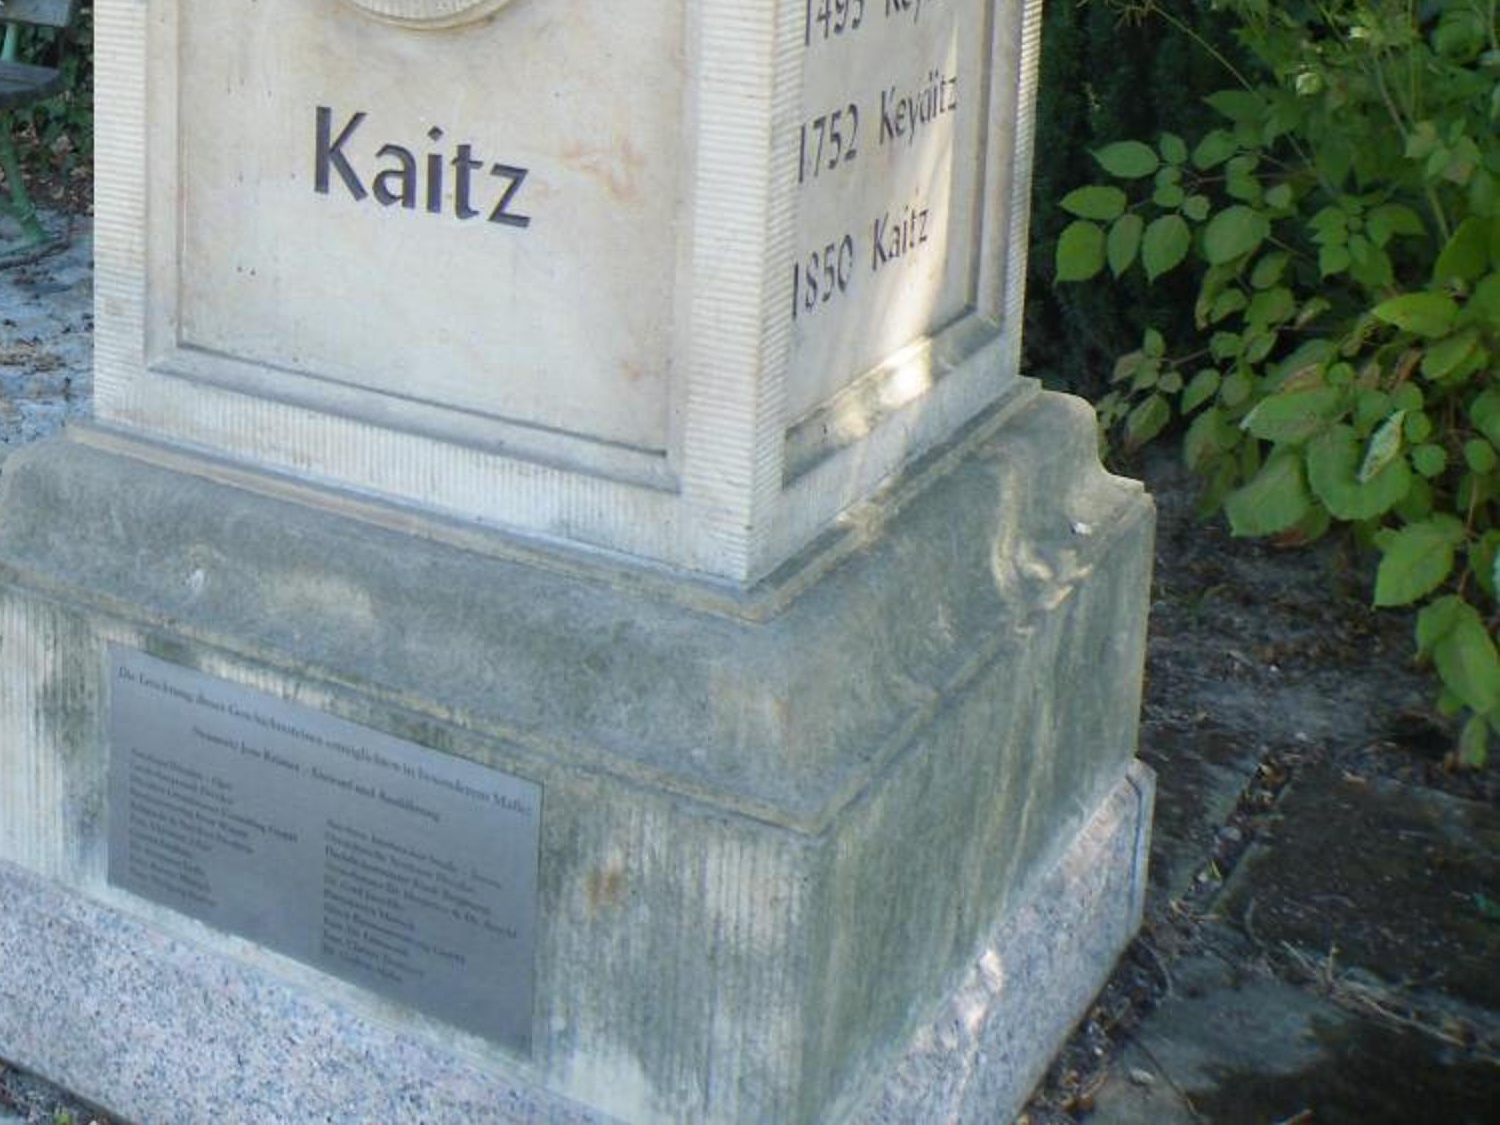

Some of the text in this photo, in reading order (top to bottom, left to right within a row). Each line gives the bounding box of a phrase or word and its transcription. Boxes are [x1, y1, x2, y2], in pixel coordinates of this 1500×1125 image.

[314, 106, 531, 228] Kaitz
[798, 103, 860, 184] 1752
[792, 205, 930, 321] 1850 Kaitz
